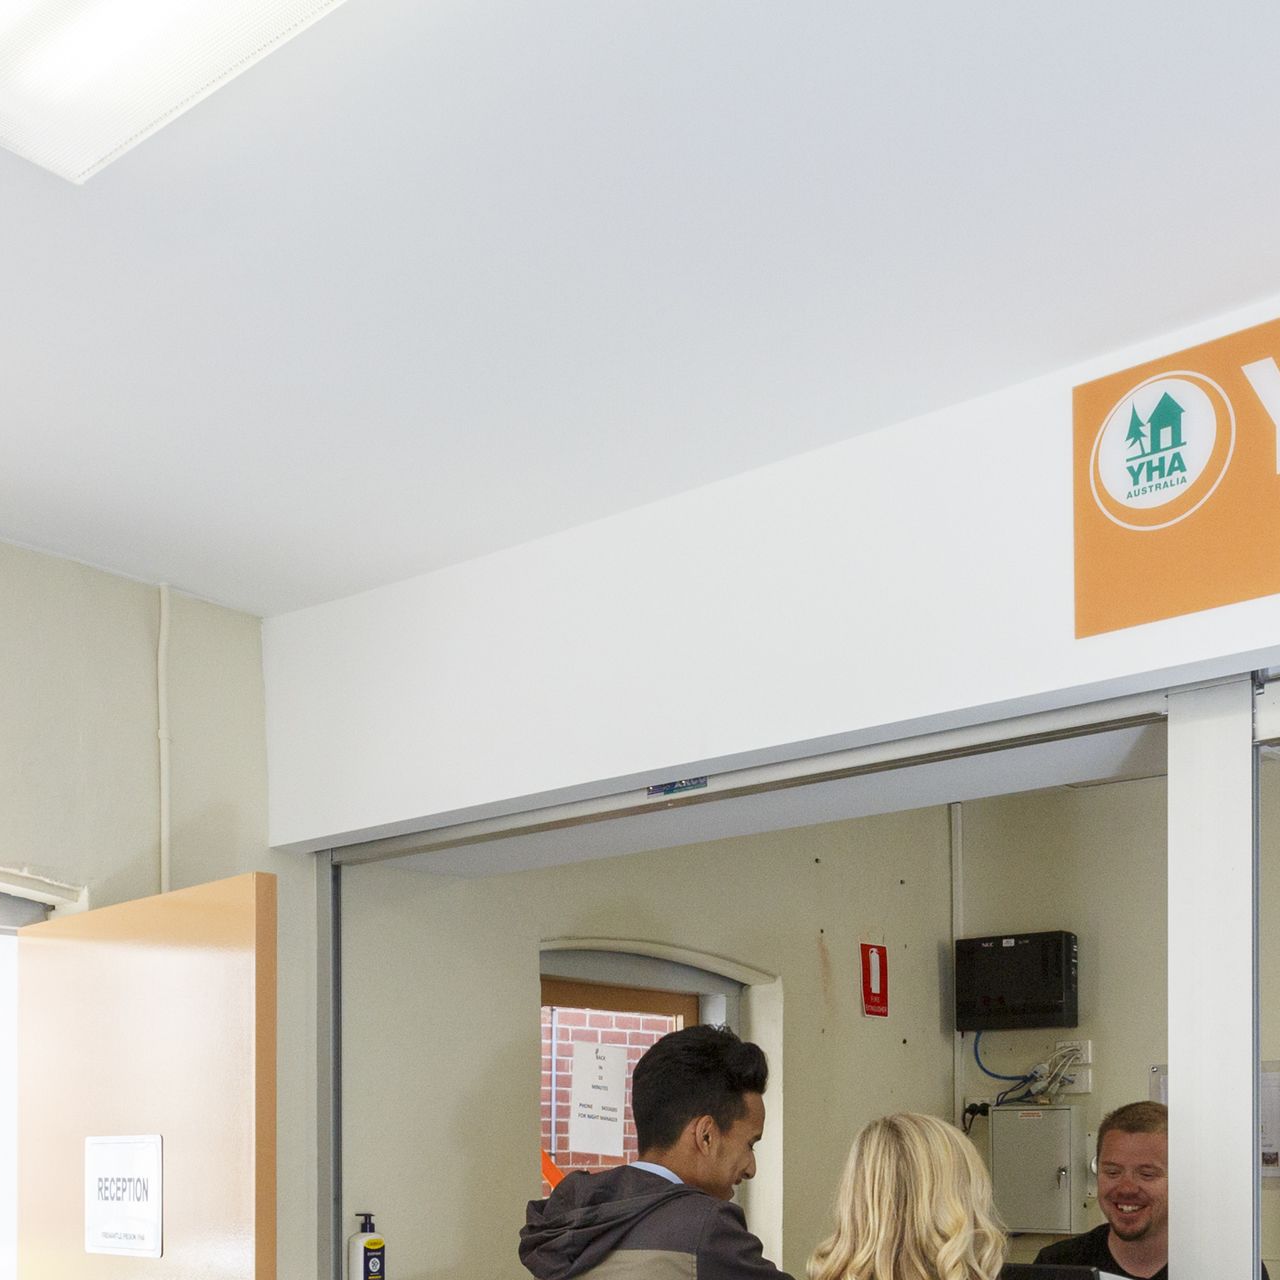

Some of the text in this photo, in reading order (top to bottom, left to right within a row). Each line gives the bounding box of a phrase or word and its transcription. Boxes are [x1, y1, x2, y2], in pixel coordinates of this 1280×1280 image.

[1126, 451, 1187, 487] YHA
[1126, 476, 1187, 499] AUSTRALIA
[97, 1177, 149, 1202] RECEPTION
